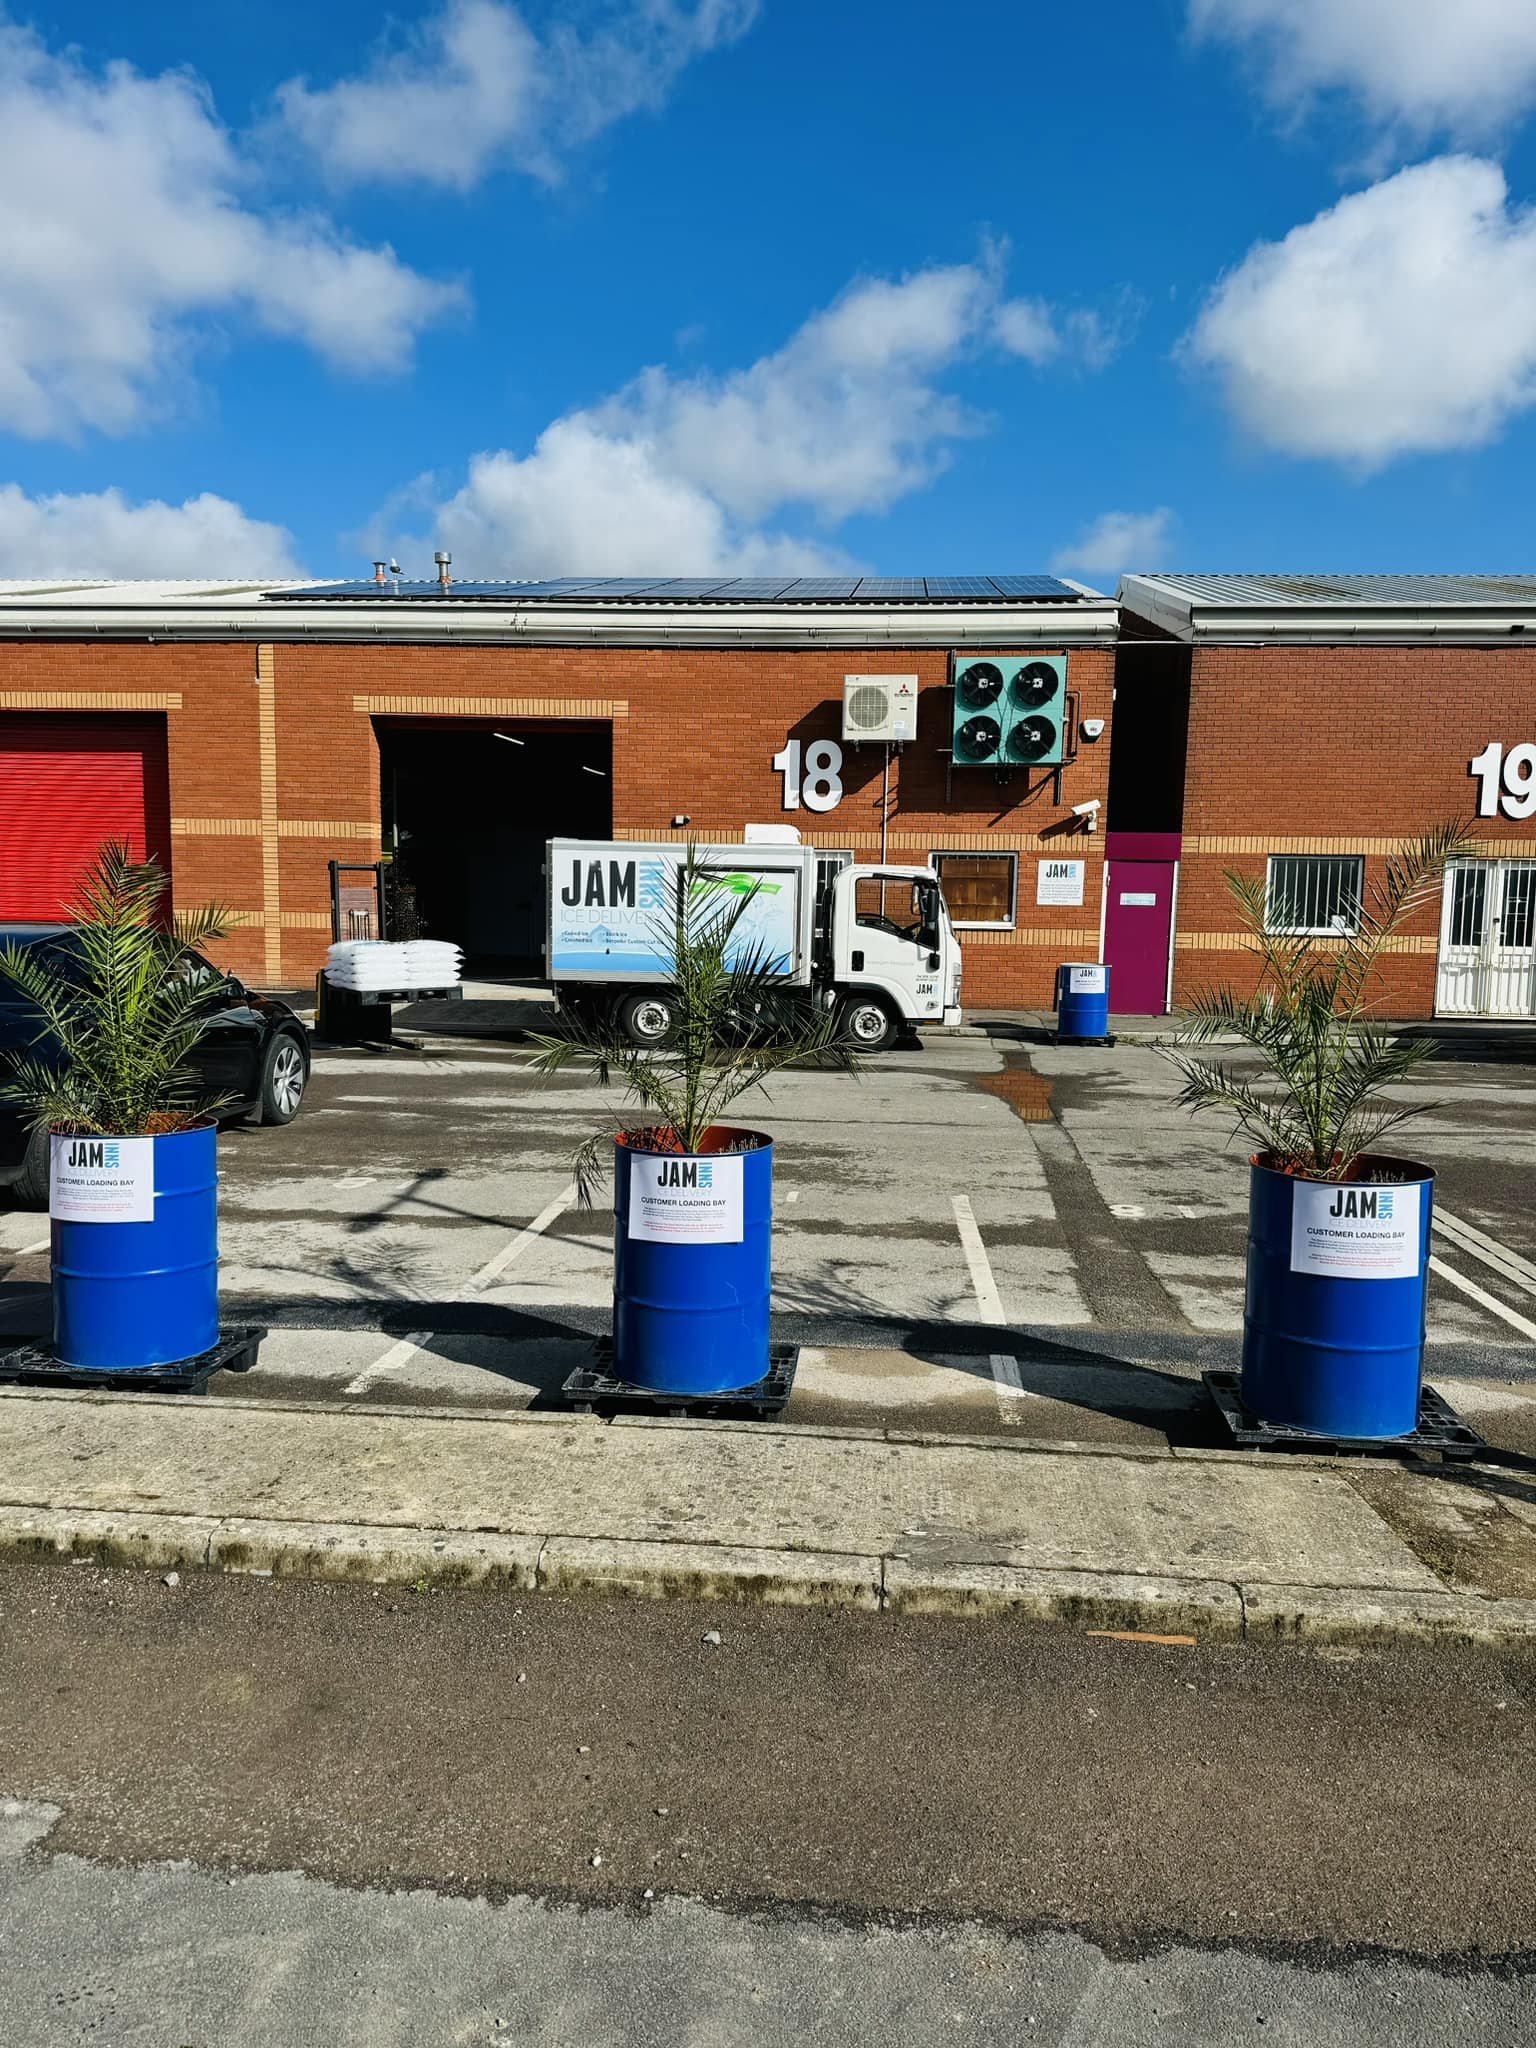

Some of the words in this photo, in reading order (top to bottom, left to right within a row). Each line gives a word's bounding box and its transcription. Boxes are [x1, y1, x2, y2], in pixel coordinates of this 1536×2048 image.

[774, 740, 843, 811] 18
[1471, 743, 1536, 819] 19
[561, 859, 636, 907] JAM
[1046, 863, 1068, 878] JAM
[560, 909, 585, 923] ICE
[1080, 969, 1093, 978] JAM
[916, 983, 933, 994] JAM
[68, 1141, 104, 1168] JAM
[104, 1143, 120, 1168] INNS
[56, 1177, 85, 1186] CUSTOMER
[86, 1179, 118, 1187] LOADING
[657, 1161, 697, 1188] JAM
[698, 1162, 713, 1188] INNS
[641, 1196, 677, 1206] CUSTOMER
[679, 1199, 711, 1207] LOADING
[1329, 1190, 1377, 1219] JAM
[1378, 1191, 1393, 1219] INNS
[1306, 1227, 1354, 1239] CUSTOMER
[1355, 1230, 1391, 1239] LOADING
